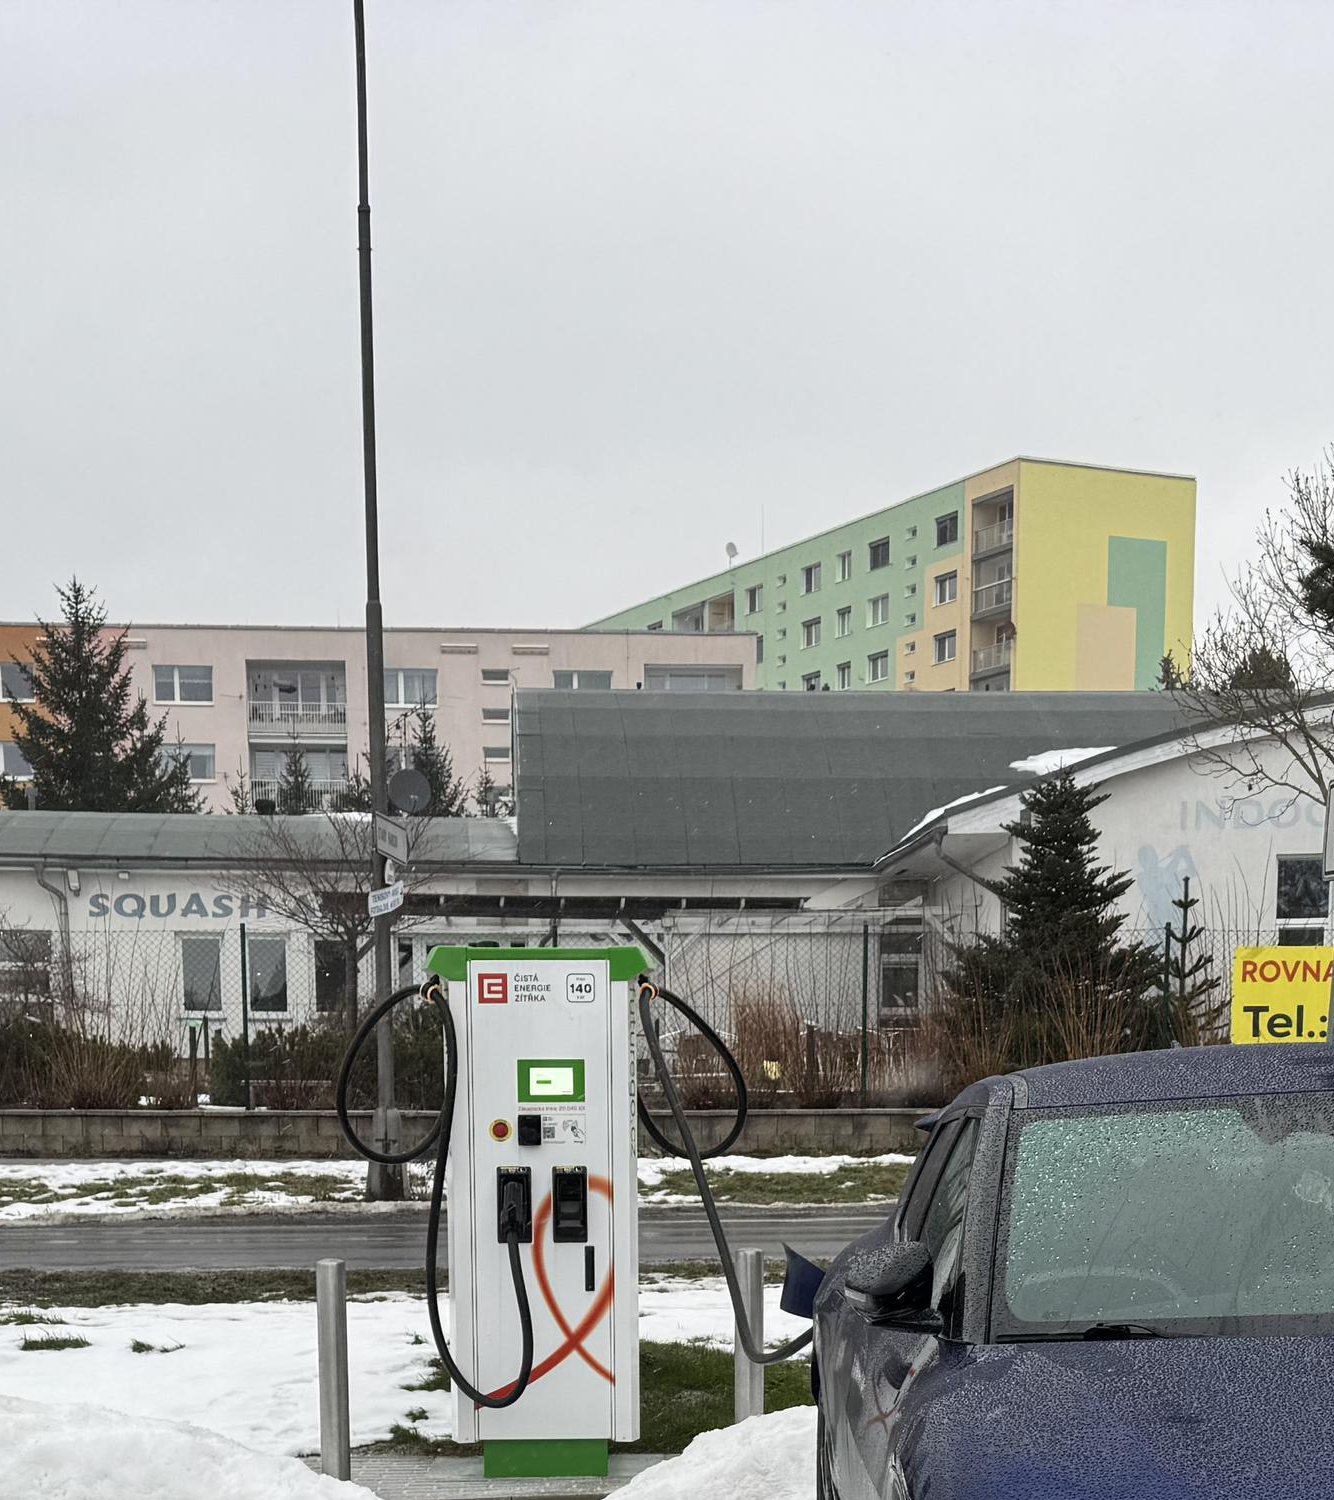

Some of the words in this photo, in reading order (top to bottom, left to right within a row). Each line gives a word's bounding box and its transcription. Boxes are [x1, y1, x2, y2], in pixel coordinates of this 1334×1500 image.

[1179, 797, 1331, 831] INDOO
[88, 892, 267, 919] SQUASH
[513, 972, 539, 982] ČISTÁ
[514, 984, 551, 992] ENERGIE
[569, 983, 592, 994] 140
[514, 993, 546, 1002] ZÍTŘKA
[1242, 1004, 1328, 1038] Tel.:
